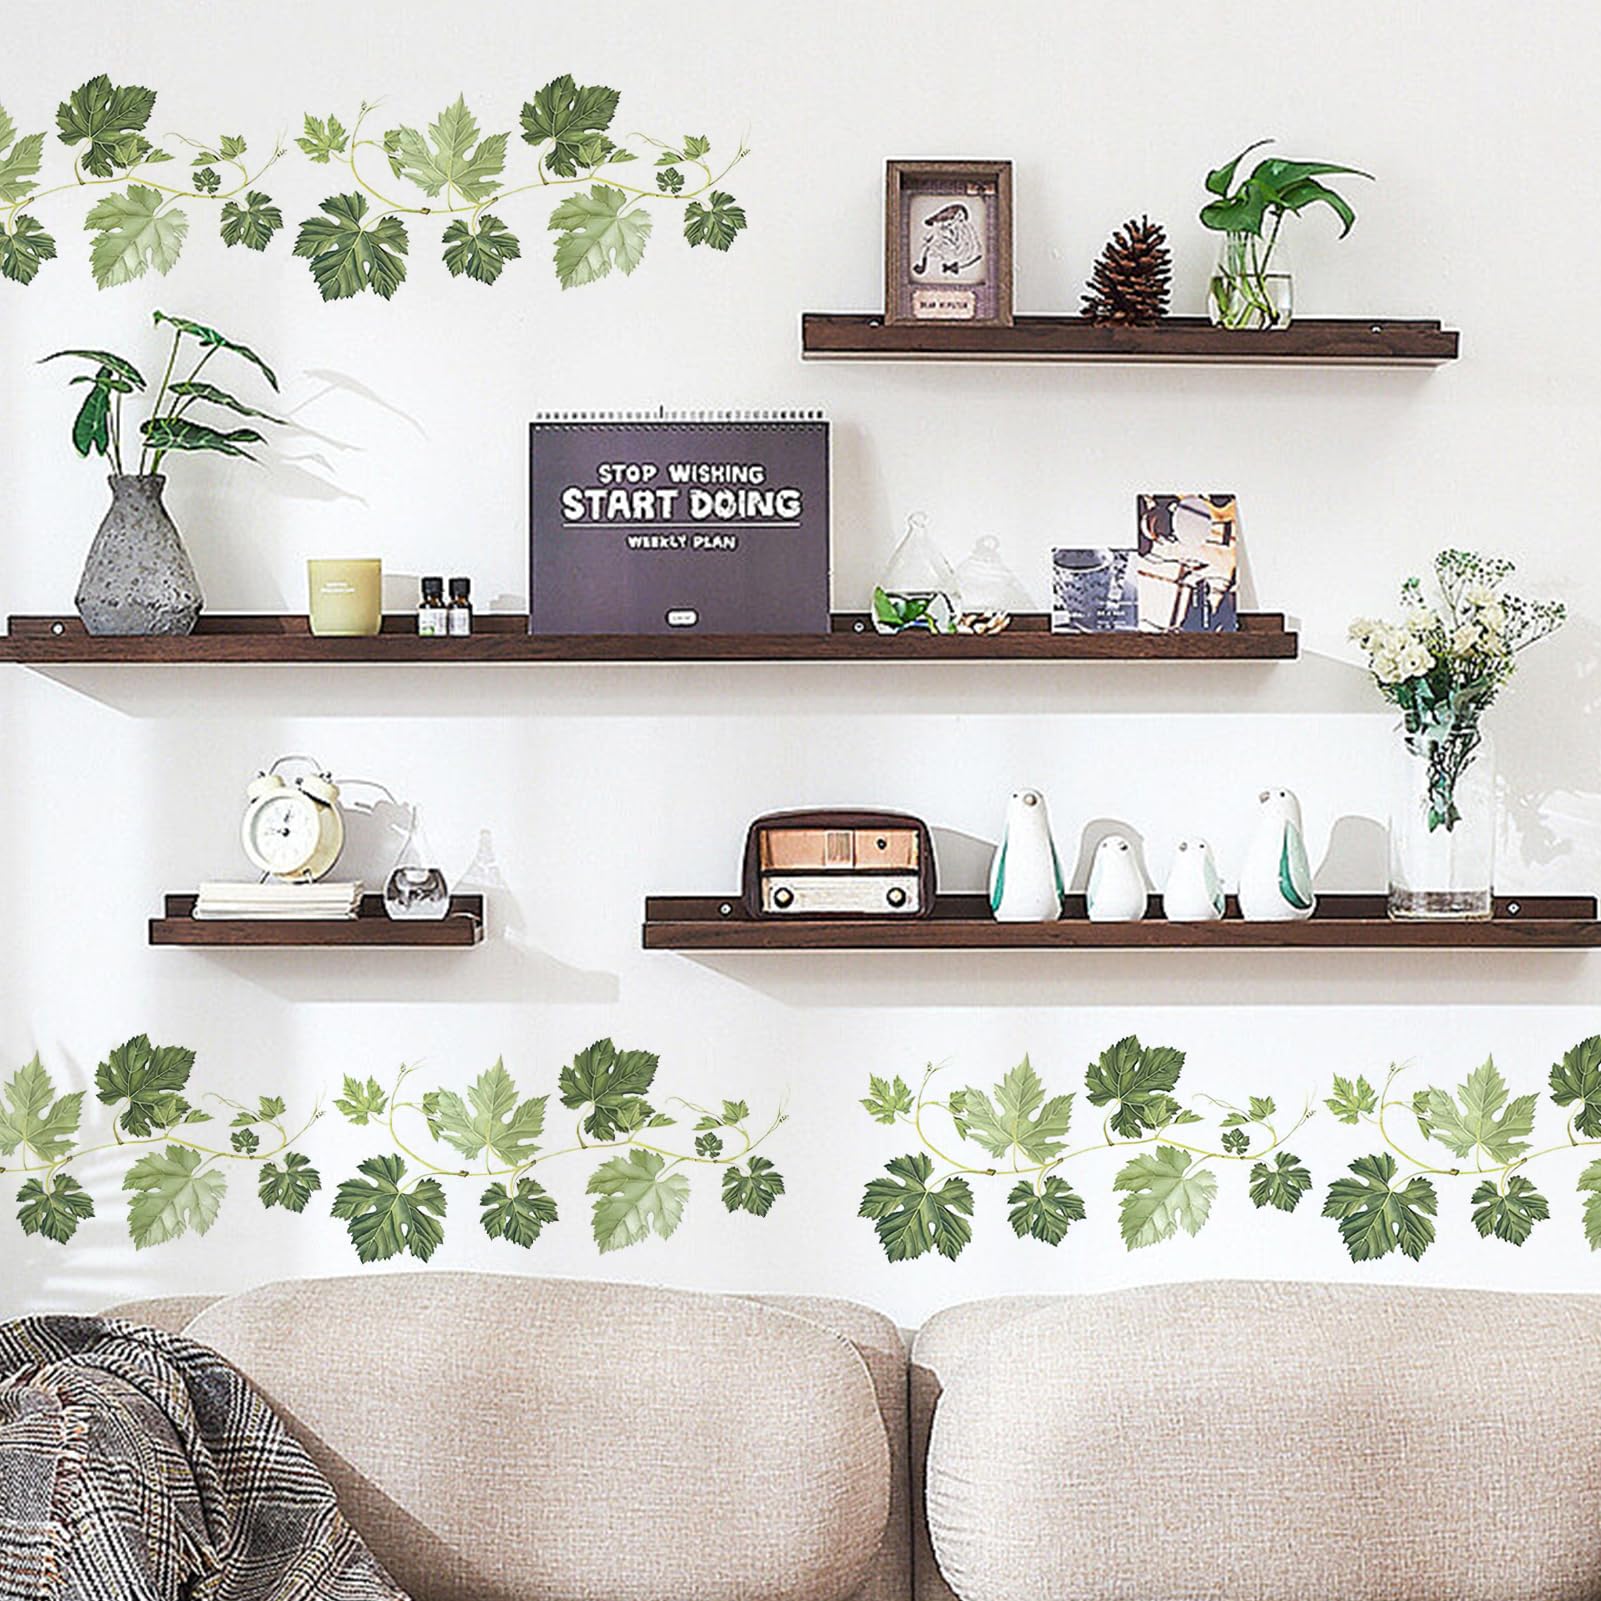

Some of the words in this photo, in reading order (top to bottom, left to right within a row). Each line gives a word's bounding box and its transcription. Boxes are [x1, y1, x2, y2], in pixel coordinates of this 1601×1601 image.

[598, 464, 658, 485] STOP
[668, 464, 766, 485] WISHING
[562, 487, 679, 521] START
[690, 488, 802, 520] DOING
[627, 535, 687, 550] WEEKLY
[693, 535, 736, 550] PLAN
